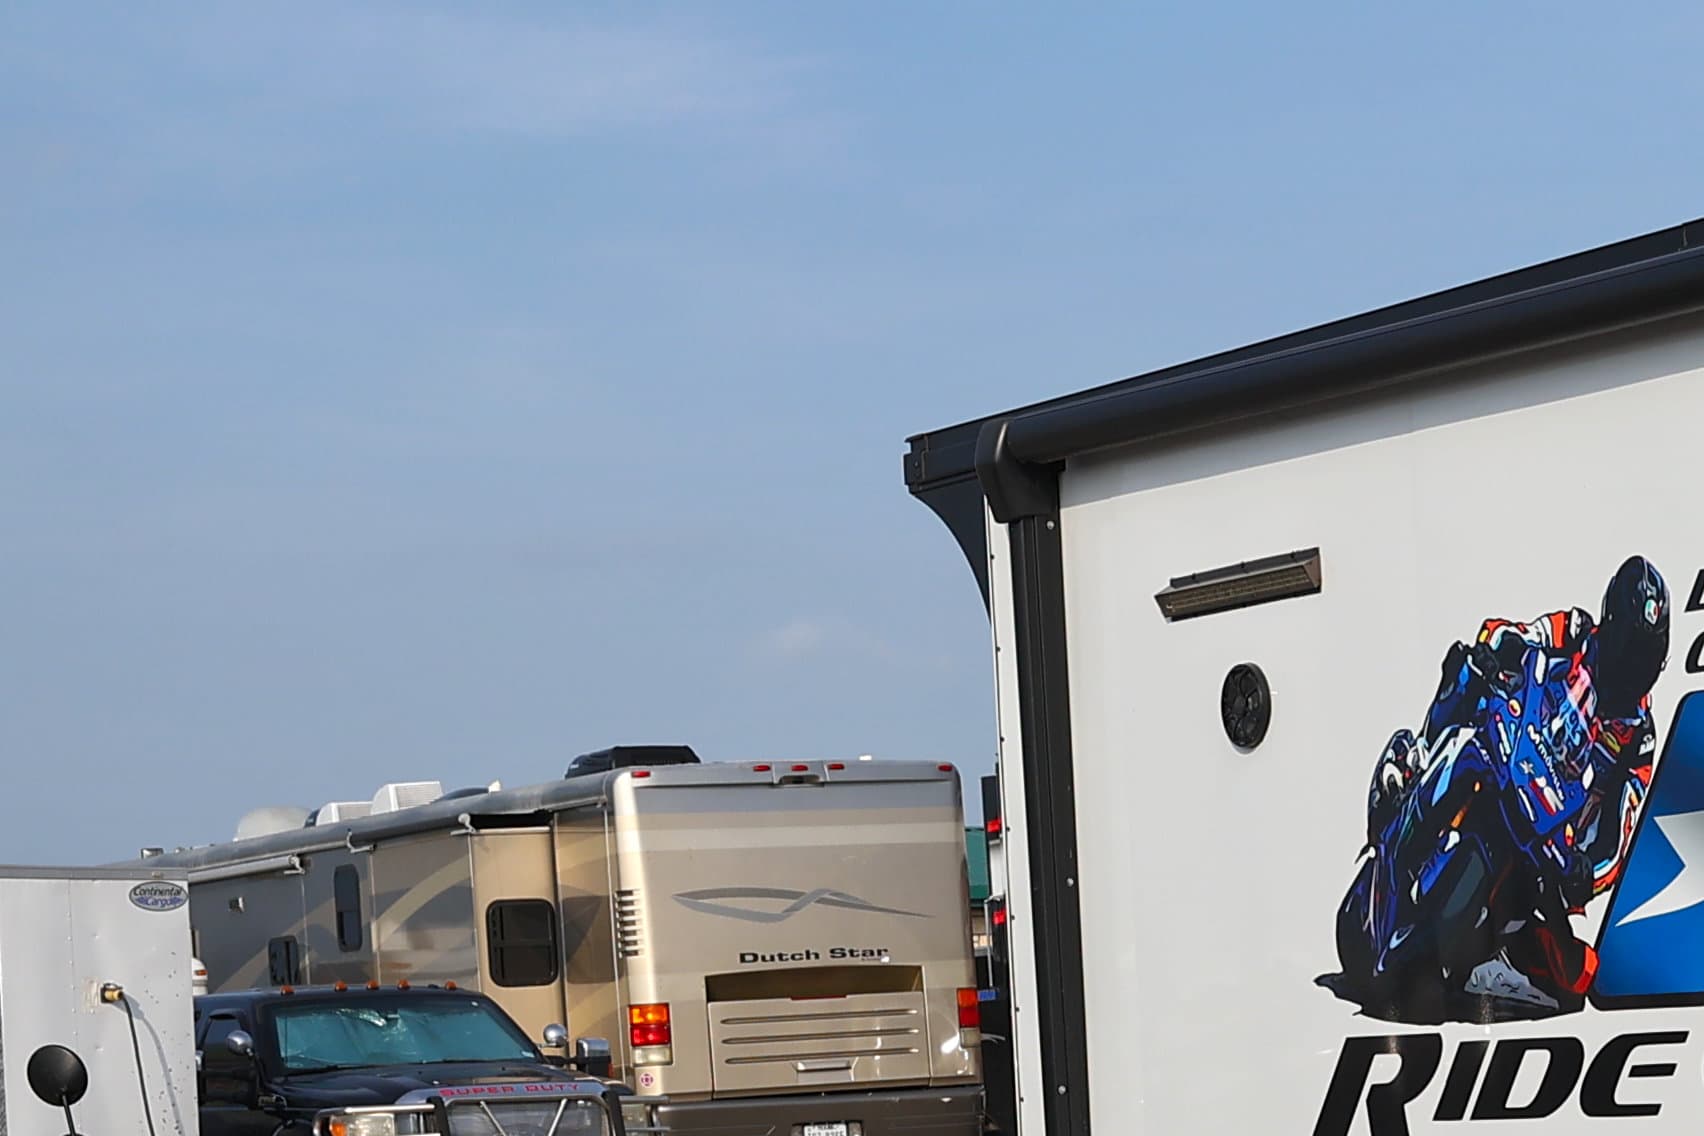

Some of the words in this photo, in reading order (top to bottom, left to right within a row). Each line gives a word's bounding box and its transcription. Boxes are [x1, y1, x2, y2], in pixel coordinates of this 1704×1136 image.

[739, 949, 820, 964] Dutch
[829, 947, 889, 960] Star
[439, 1084, 514, 1097] SUPER
[525, 1083, 579, 1093] DUTY
